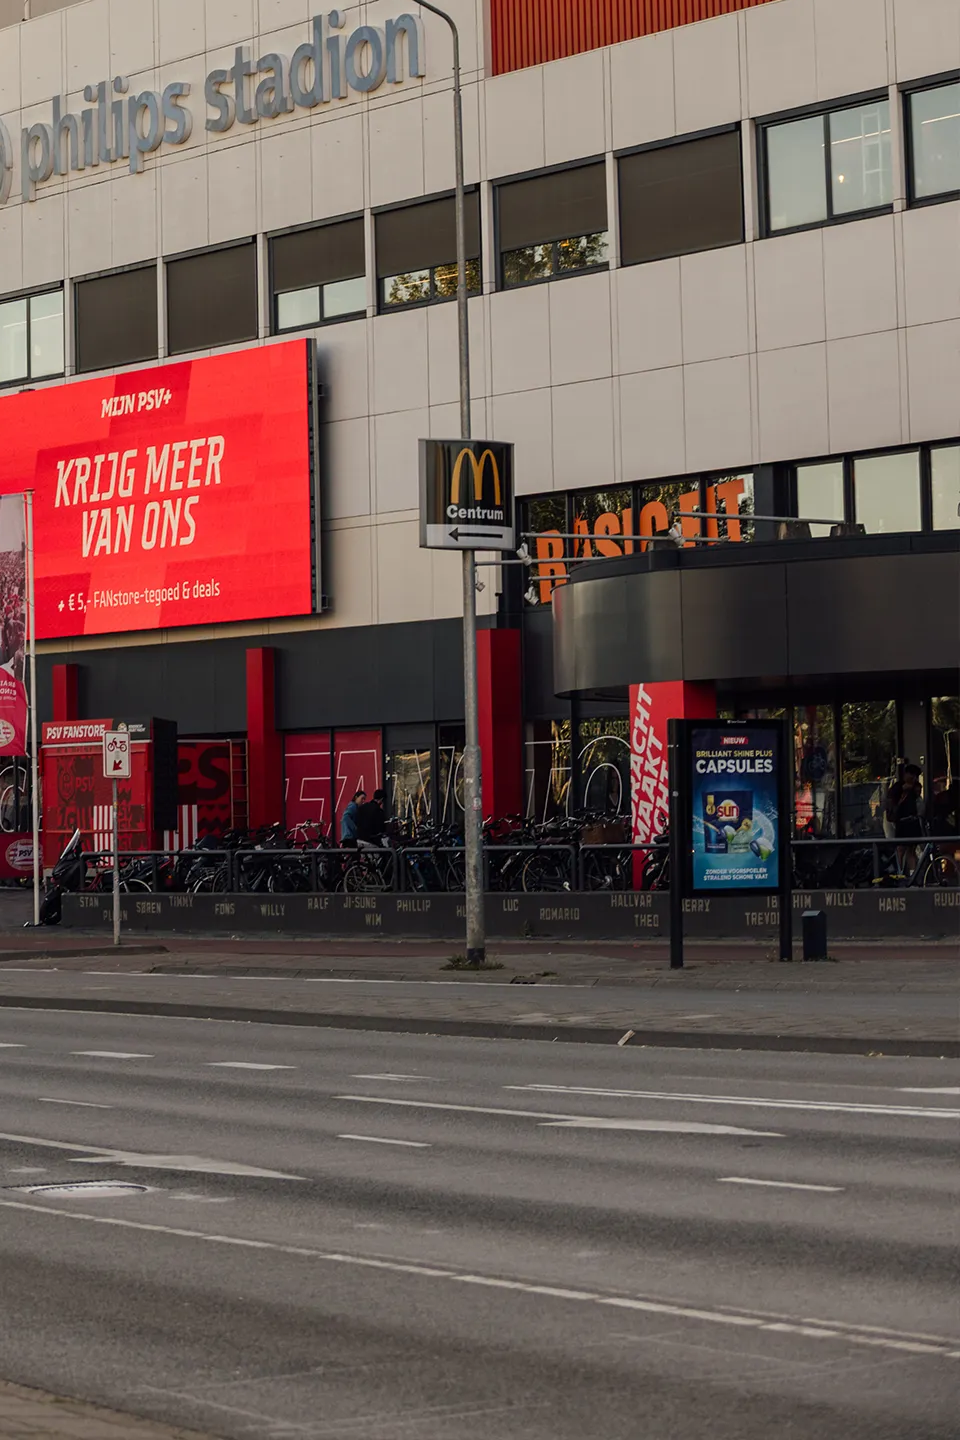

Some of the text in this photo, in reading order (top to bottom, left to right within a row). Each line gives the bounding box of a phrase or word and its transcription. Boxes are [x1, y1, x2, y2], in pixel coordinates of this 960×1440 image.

[21, 9, 426, 203] philips stadion
[101, 387, 172, 418] MIJN PSV+
[54, 435, 225, 508] KRIJG MEER
[446, 504, 504, 521] Centrum
[81, 495, 200, 558] VAN ONS
[536, 478, 744, 604] BASIC FIT
[93, 582, 180, 609] FANstore-tegoed
[182, 581, 191, 600] &
[192, 578, 220, 599] deals
[46, 724, 105, 740] PSV FANSTORE
[723, 737, 746, 745] NIEUW
[695, 749, 773, 758] BRILLIANT SHINE PLUS
[695, 759, 773, 774] CAPSULES
[634, 725, 664, 852] MAAKT
[650, 759, 670, 844] CHT
[717, 805, 738, 817] sun
[18, 849, 33, 858] PSV
[79, 896, 99, 908] STAN
[168, 895, 194, 907] TIMMY
[307, 897, 329, 910] RALF
[343, 896, 376, 909] JI-SUNG
[396, 899, 431, 912] PHILLIP
[502, 899, 519, 912] LUC
[610, 894, 652, 908] HALLVAR
[681, 898, 711, 912] ERRY
[825, 893, 854, 907] WILLY
[878, 898, 907, 912] HANS
[136, 901, 162, 914] SØREN
[214, 903, 235, 915] FONS
[260, 904, 285, 916] WILLY
[539, 907, 580, 921] ROMARIO
[365, 913, 382, 926] WIM
[634, 914, 659, 927] THEO
